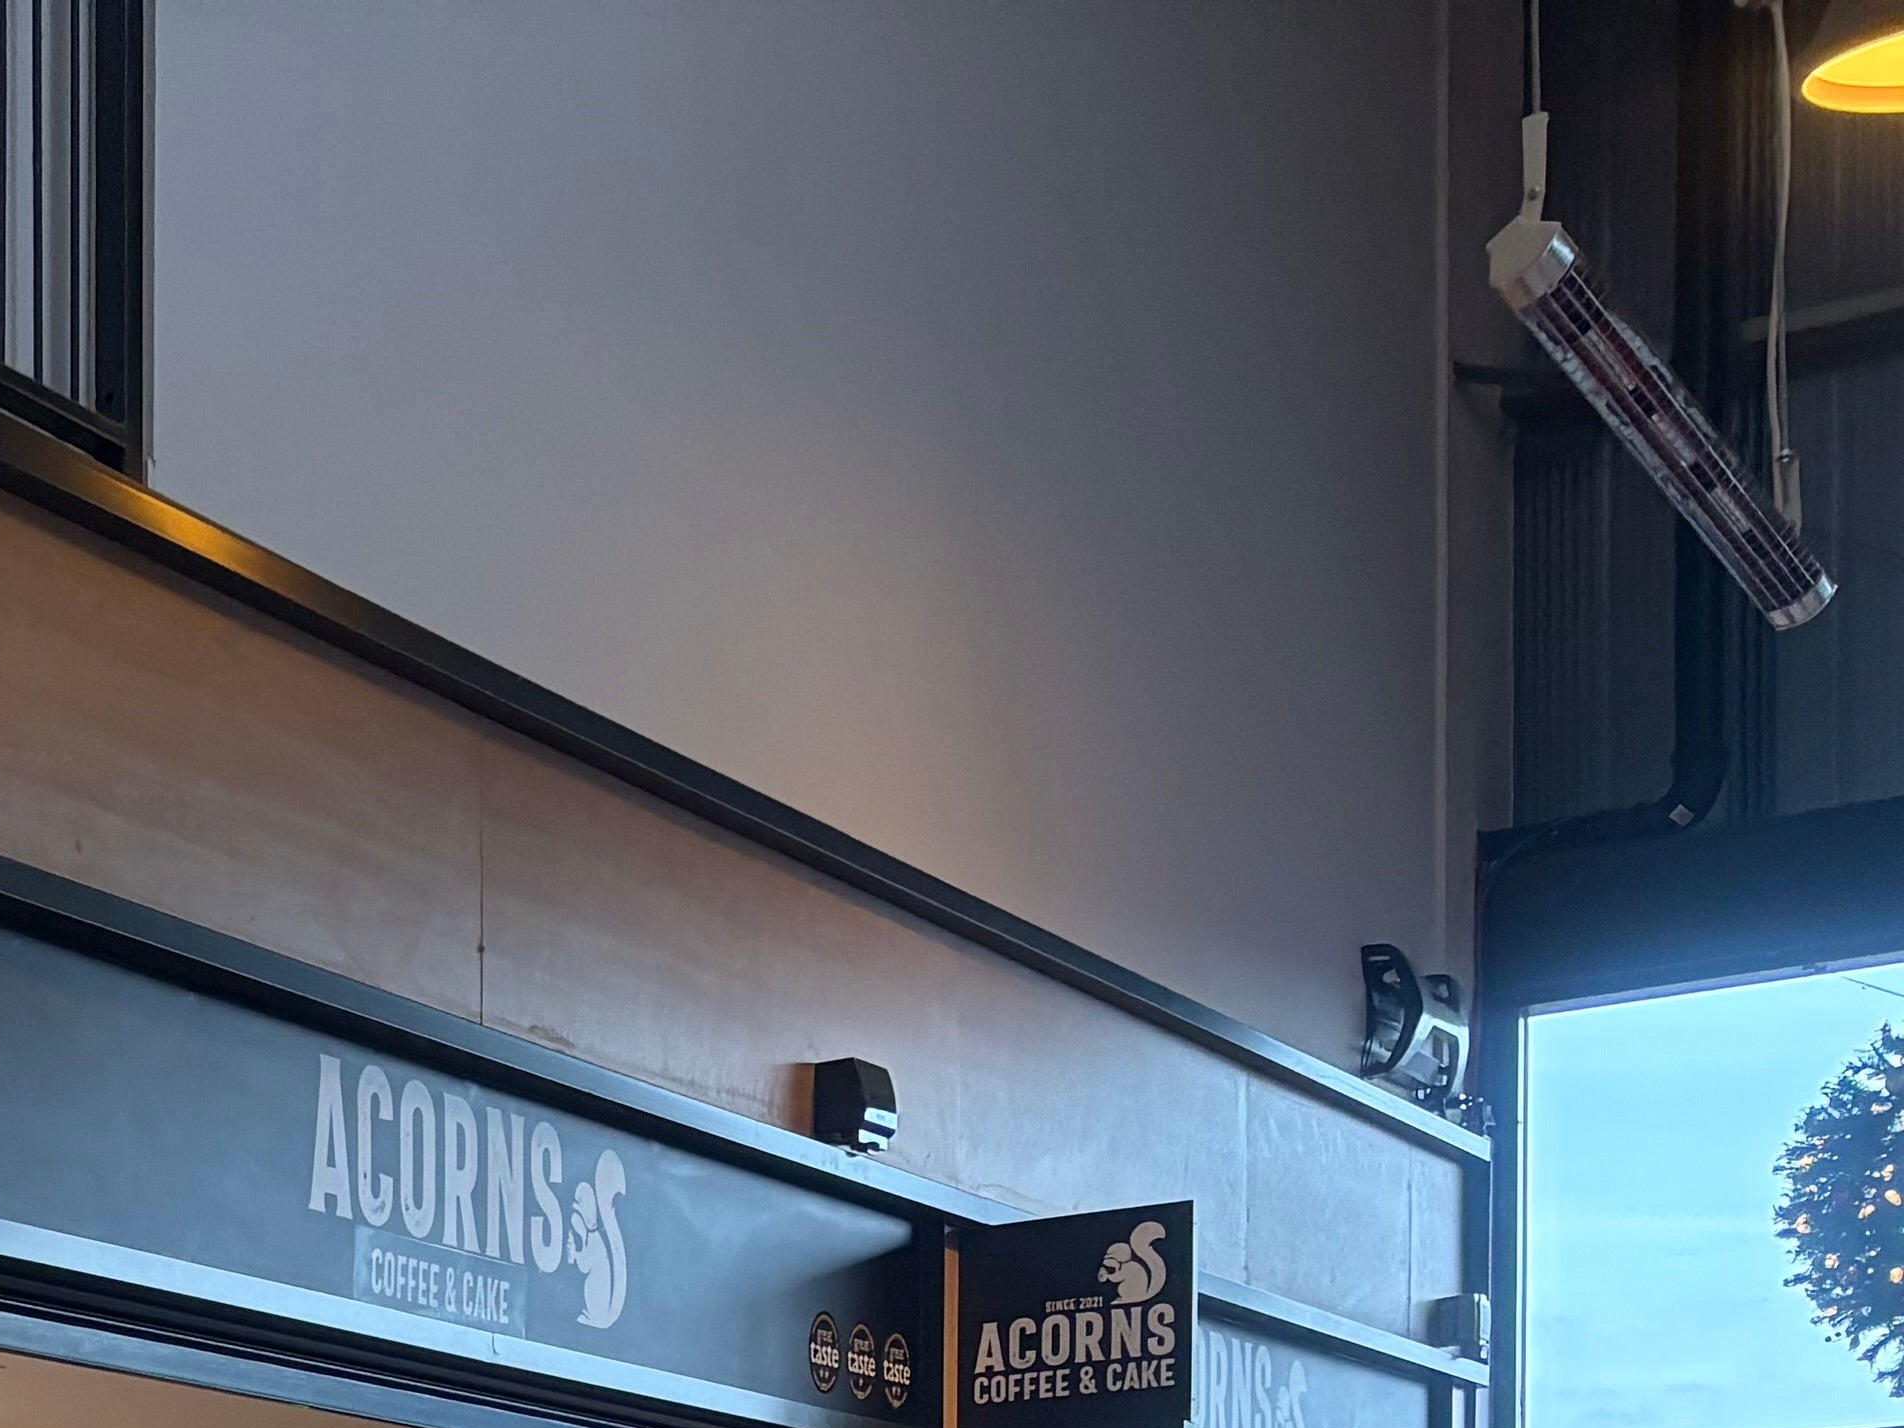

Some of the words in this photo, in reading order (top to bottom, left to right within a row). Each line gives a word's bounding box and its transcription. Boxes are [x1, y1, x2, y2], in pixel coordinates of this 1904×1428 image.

[308, 1054, 562, 1273] ACORNS
[371, 1248, 438, 1309] COFFEE
[445, 1267, 457, 1313] &
[463, 1271, 510, 1324] CAKE
[1046, 1298, 1076, 1313] SINCE
[1080, 1297, 1103, 1309] 2021
[811, 1342, 839, 1368] taste
[974, 1303, 1175, 1374] ACORNS
[848, 1351, 876, 1377] taste
[883, 1360, 910, 1385] taste
[974, 1369, 1070, 1404] COFFEE
[1080, 1366, 1097, 1394] &
[1107, 1358, 1175, 1391] CAKE
